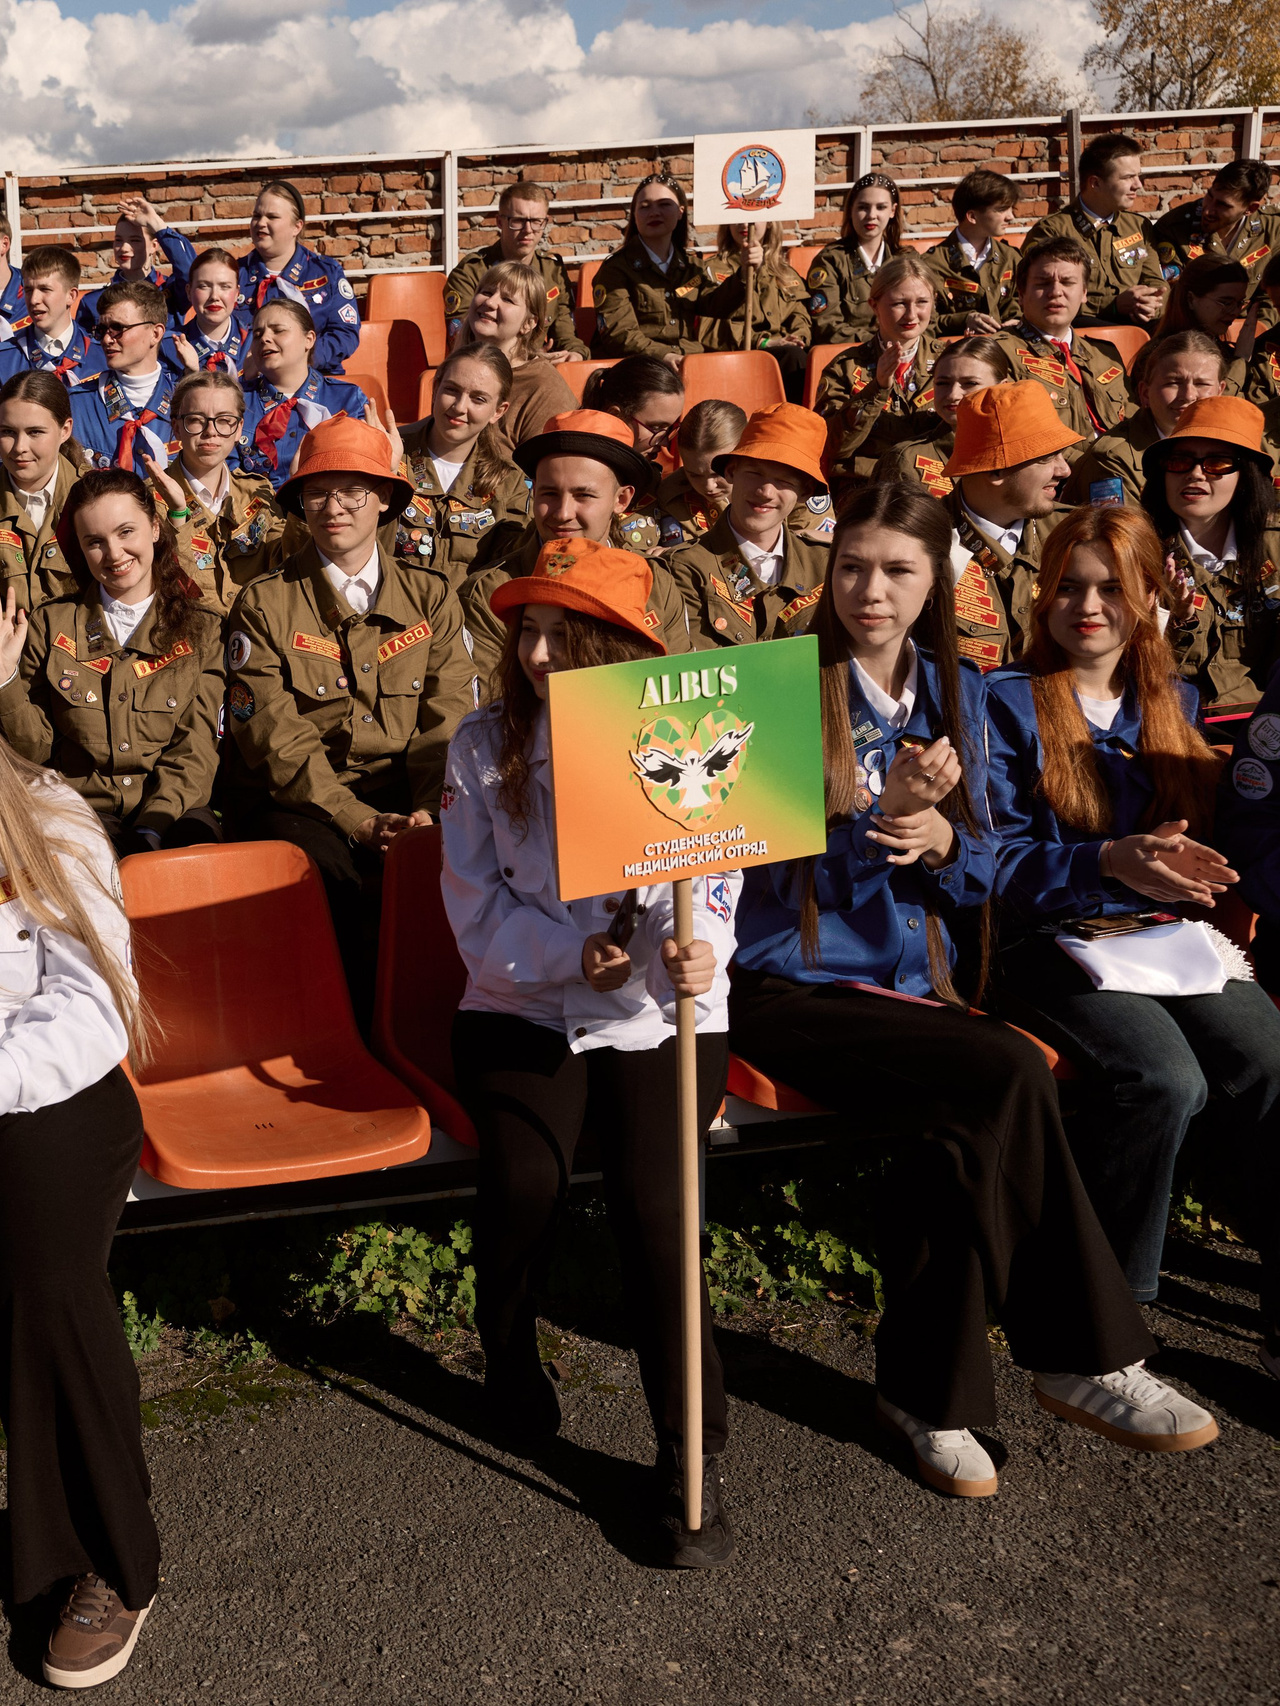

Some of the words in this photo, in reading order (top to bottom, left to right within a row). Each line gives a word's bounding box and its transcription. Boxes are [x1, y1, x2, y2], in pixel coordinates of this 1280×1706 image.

[638, 664, 738, 709] ALBUS
[623, 845, 722, 878] МЕДИЦИНСКИЙ
[725, 840, 768, 861] ОТРЯД
[644, 824, 746, 857] СТУДЕНЧЕСКИЙ
